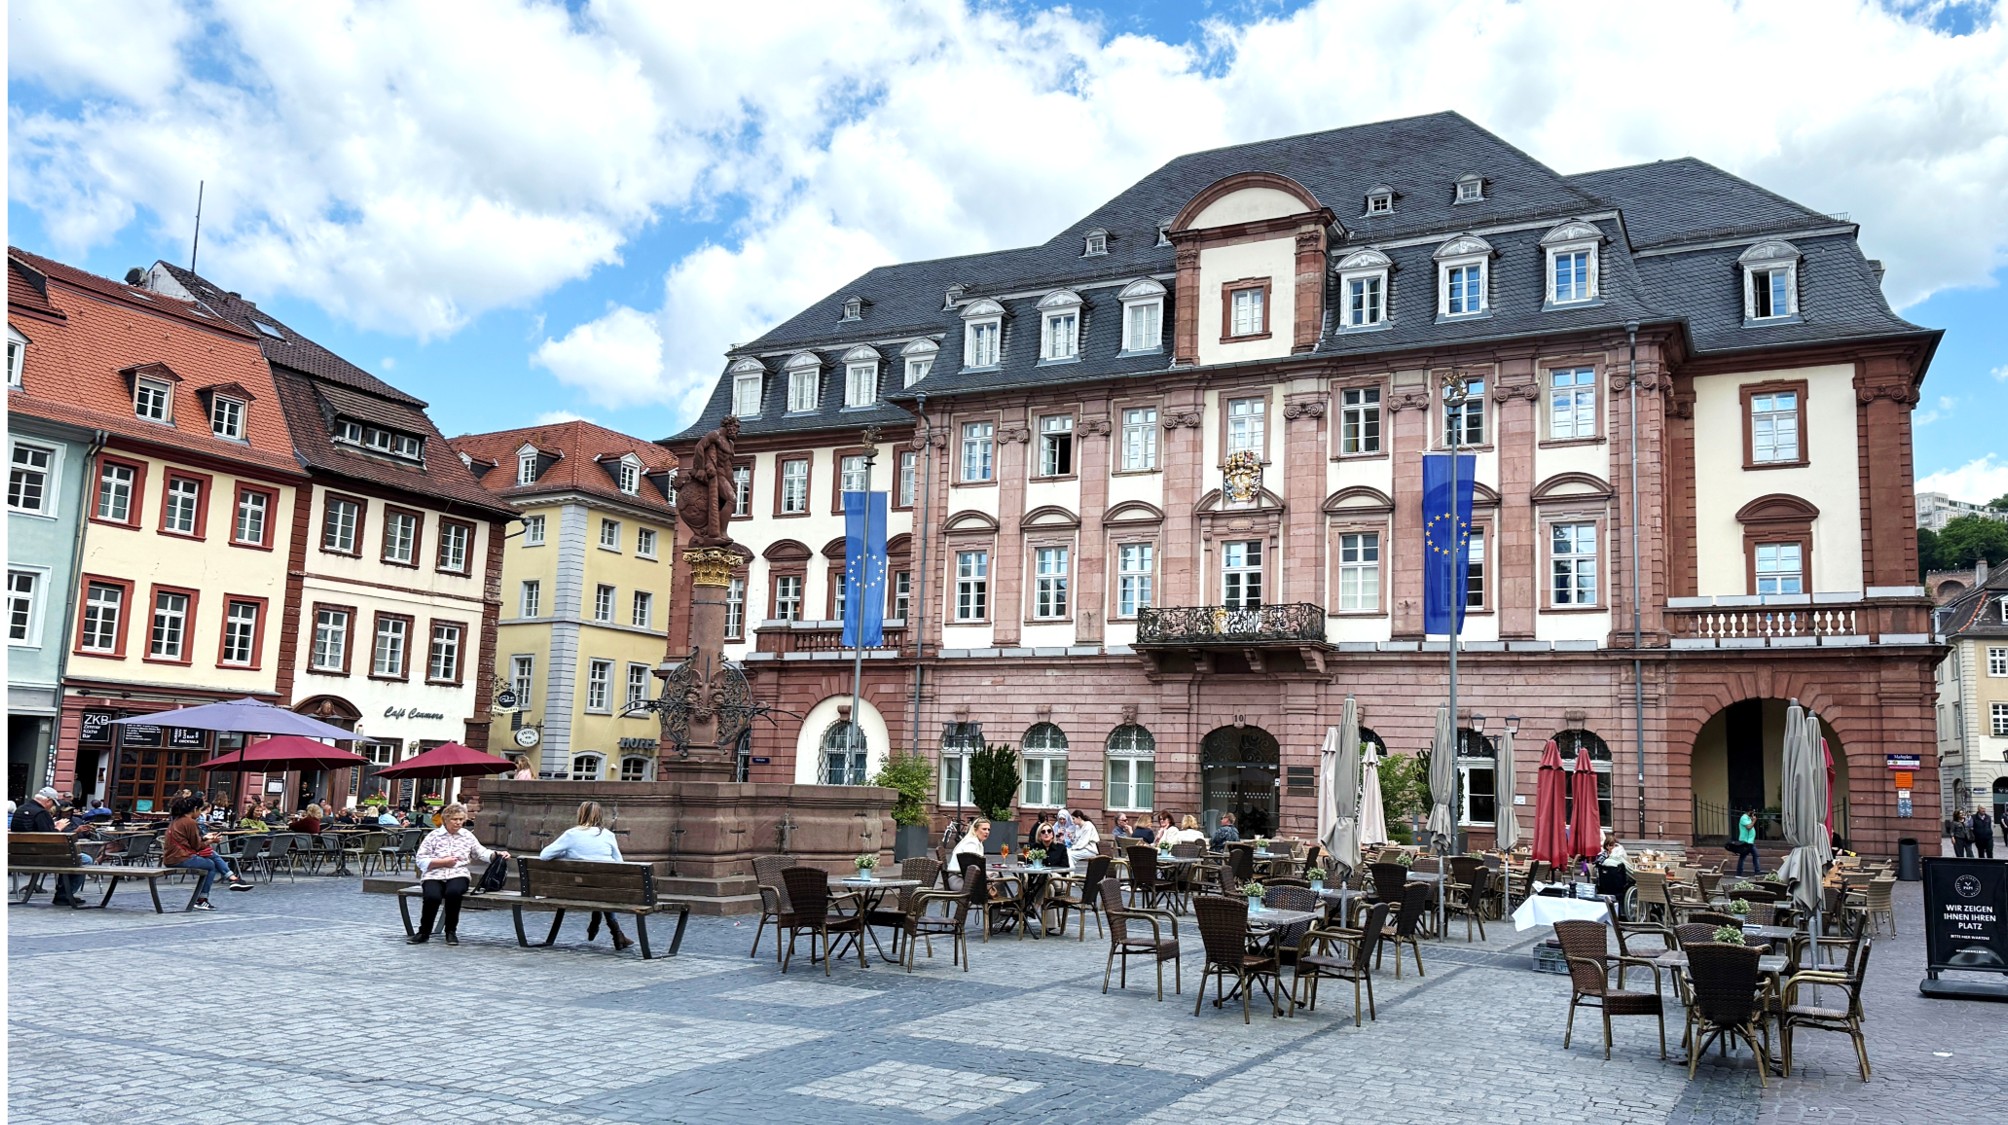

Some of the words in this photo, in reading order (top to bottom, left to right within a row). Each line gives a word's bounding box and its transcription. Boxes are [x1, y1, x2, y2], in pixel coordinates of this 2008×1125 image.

[384, 706, 406, 720] Café
[84, 714, 109, 725] ZKB
[1234, 714, 1244, 722] 10
[620, 737, 656, 748] HOTEL
[212, 810, 225, 820] 92
[1945, 904, 1962, 912] WIR
[1963, 904, 1993, 913] ZEIGEN
[1971, 914, 1996, 922] IHREN
[1958, 922, 1983, 930] PLATZ
